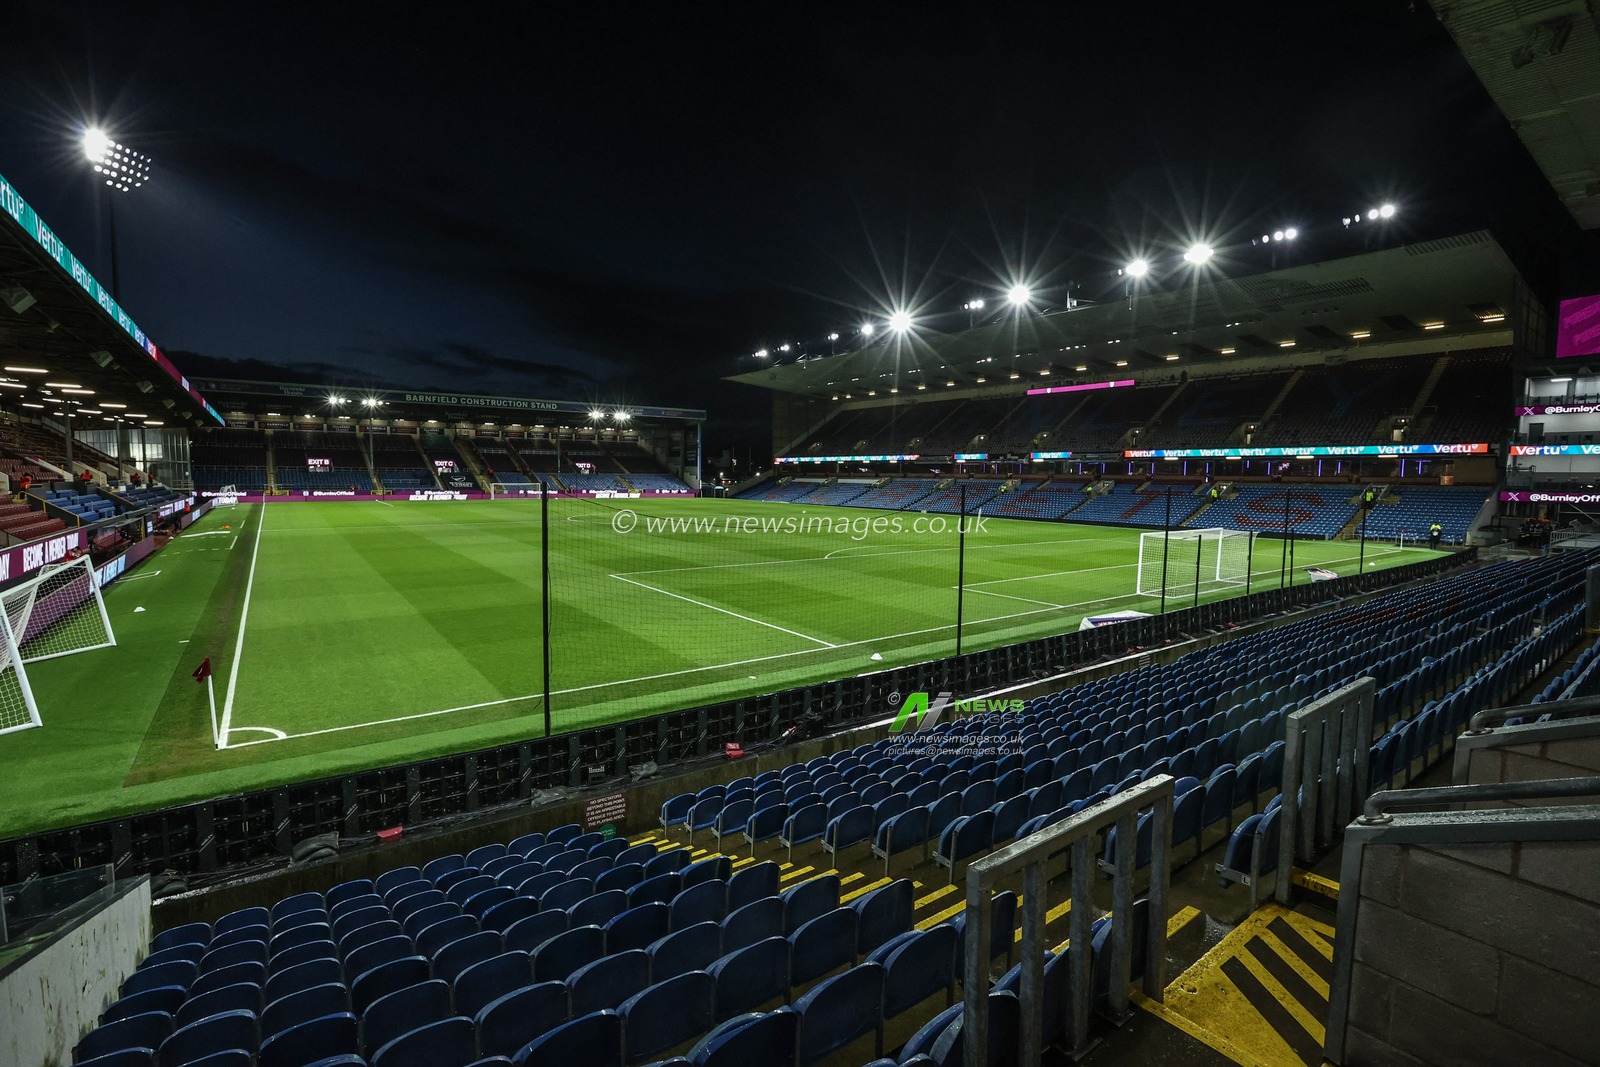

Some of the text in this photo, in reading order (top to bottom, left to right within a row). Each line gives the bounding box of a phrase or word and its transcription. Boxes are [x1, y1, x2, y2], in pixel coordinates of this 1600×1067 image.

[0, 181, 20, 221] rtu
[35, 213, 61, 263] Vertu
[405, 394, 558, 410] BARNFIELD CONSTRUCTION STAND
[1163, 449, 1187, 457] Vertu
[1200, 449, 1225, 457] Vertu
[1238, 448, 1266, 456] Vertu
[1327, 446, 1360, 455] Vertu
[1377, 445, 1413, 454] Vertu
[1432, 444, 1471, 453] Vertu
[1516, 446, 1560, 455] Vertu
[23, 543, 44, 573] BECOME
[49, 536, 67, 562] MEMBER
[598, 794, 622, 803] SPECTATORS
[602, 803, 626, 812] ARRESTABLE
[587, 814, 606, 822] OFFENCE
